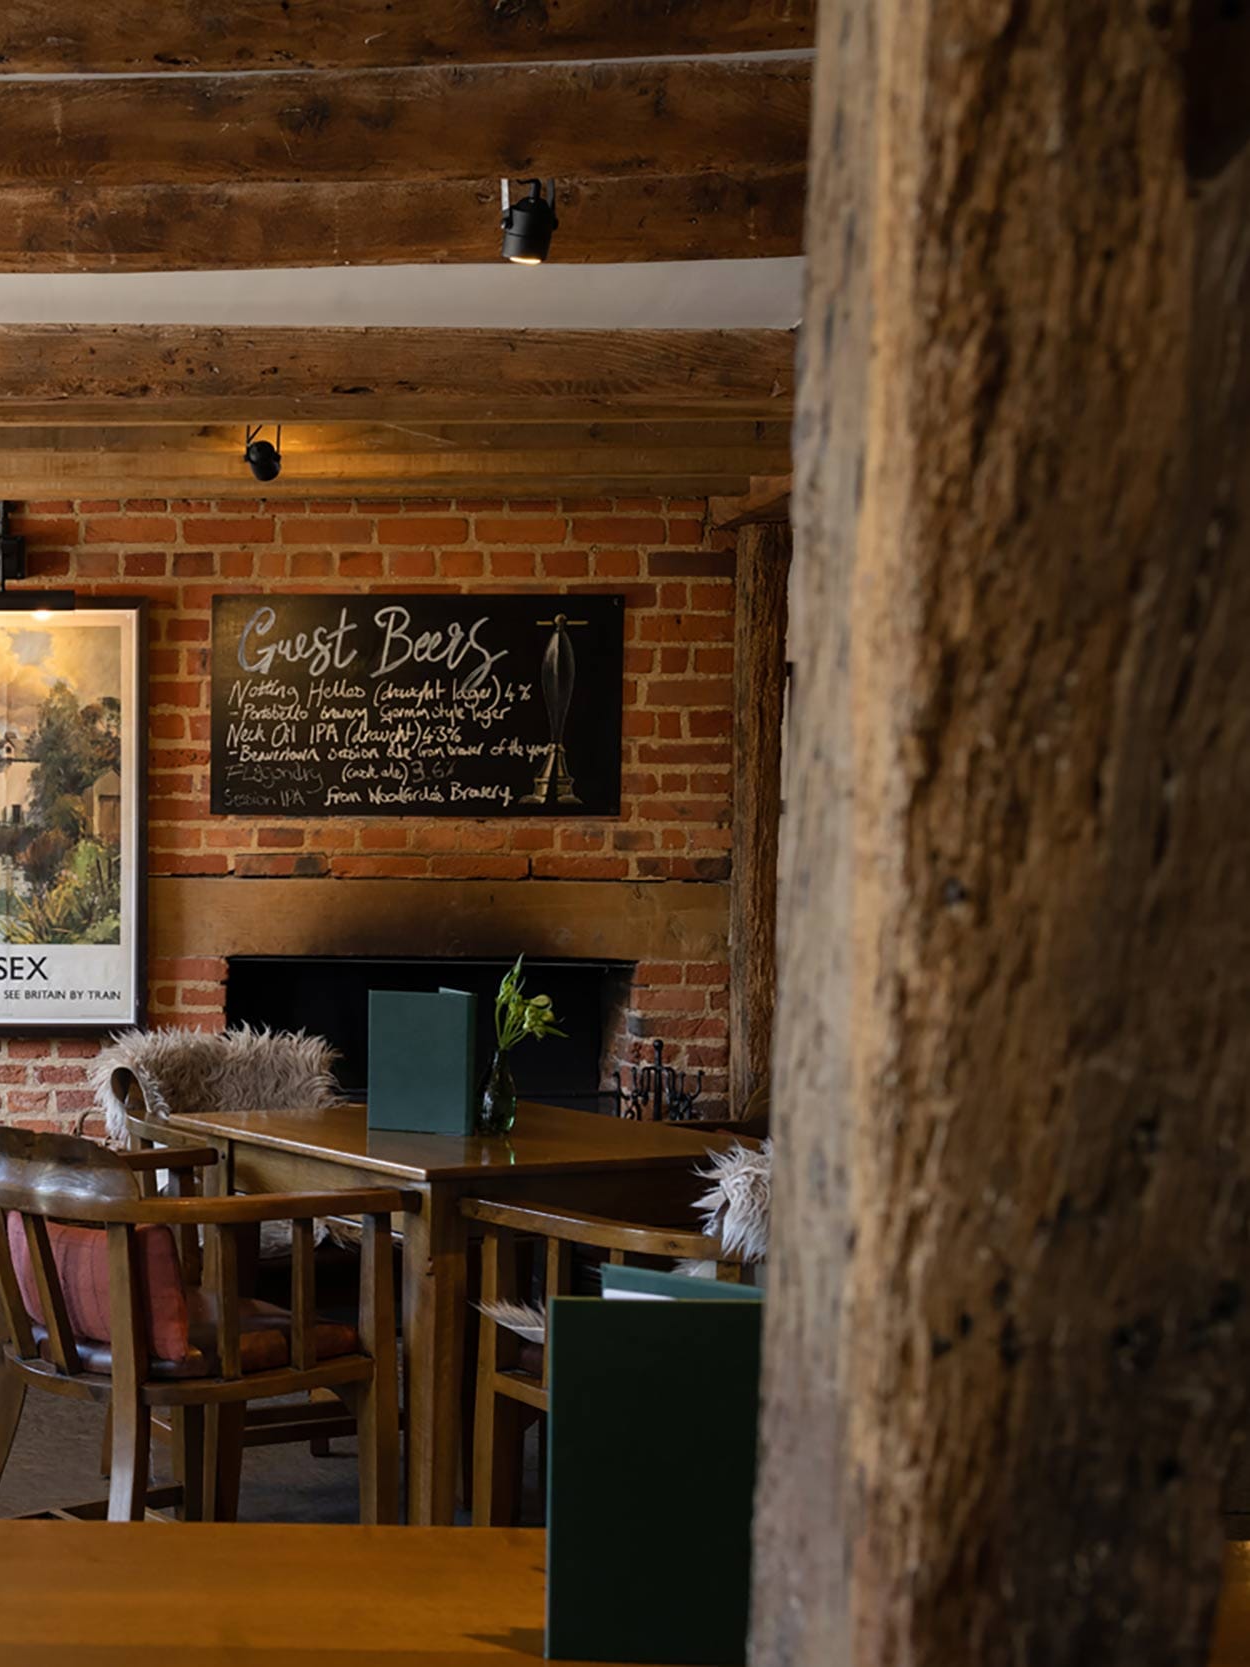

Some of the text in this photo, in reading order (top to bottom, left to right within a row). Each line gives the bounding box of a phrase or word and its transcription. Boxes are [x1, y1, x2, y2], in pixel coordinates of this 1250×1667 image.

[238, 606, 508, 692] Guest Beers
[228, 679, 299, 708] Notting
[226, 722, 266, 747] Neck
[271, 722, 296, 747] Oil
[310, 723, 339, 744] IPA
[490, 738, 507, 756] of
[280, 788, 306, 807] IPA
[324, 785, 361, 806] from
[4, 990, 121, 1001] SEE BRITAIN BY TRAIN
